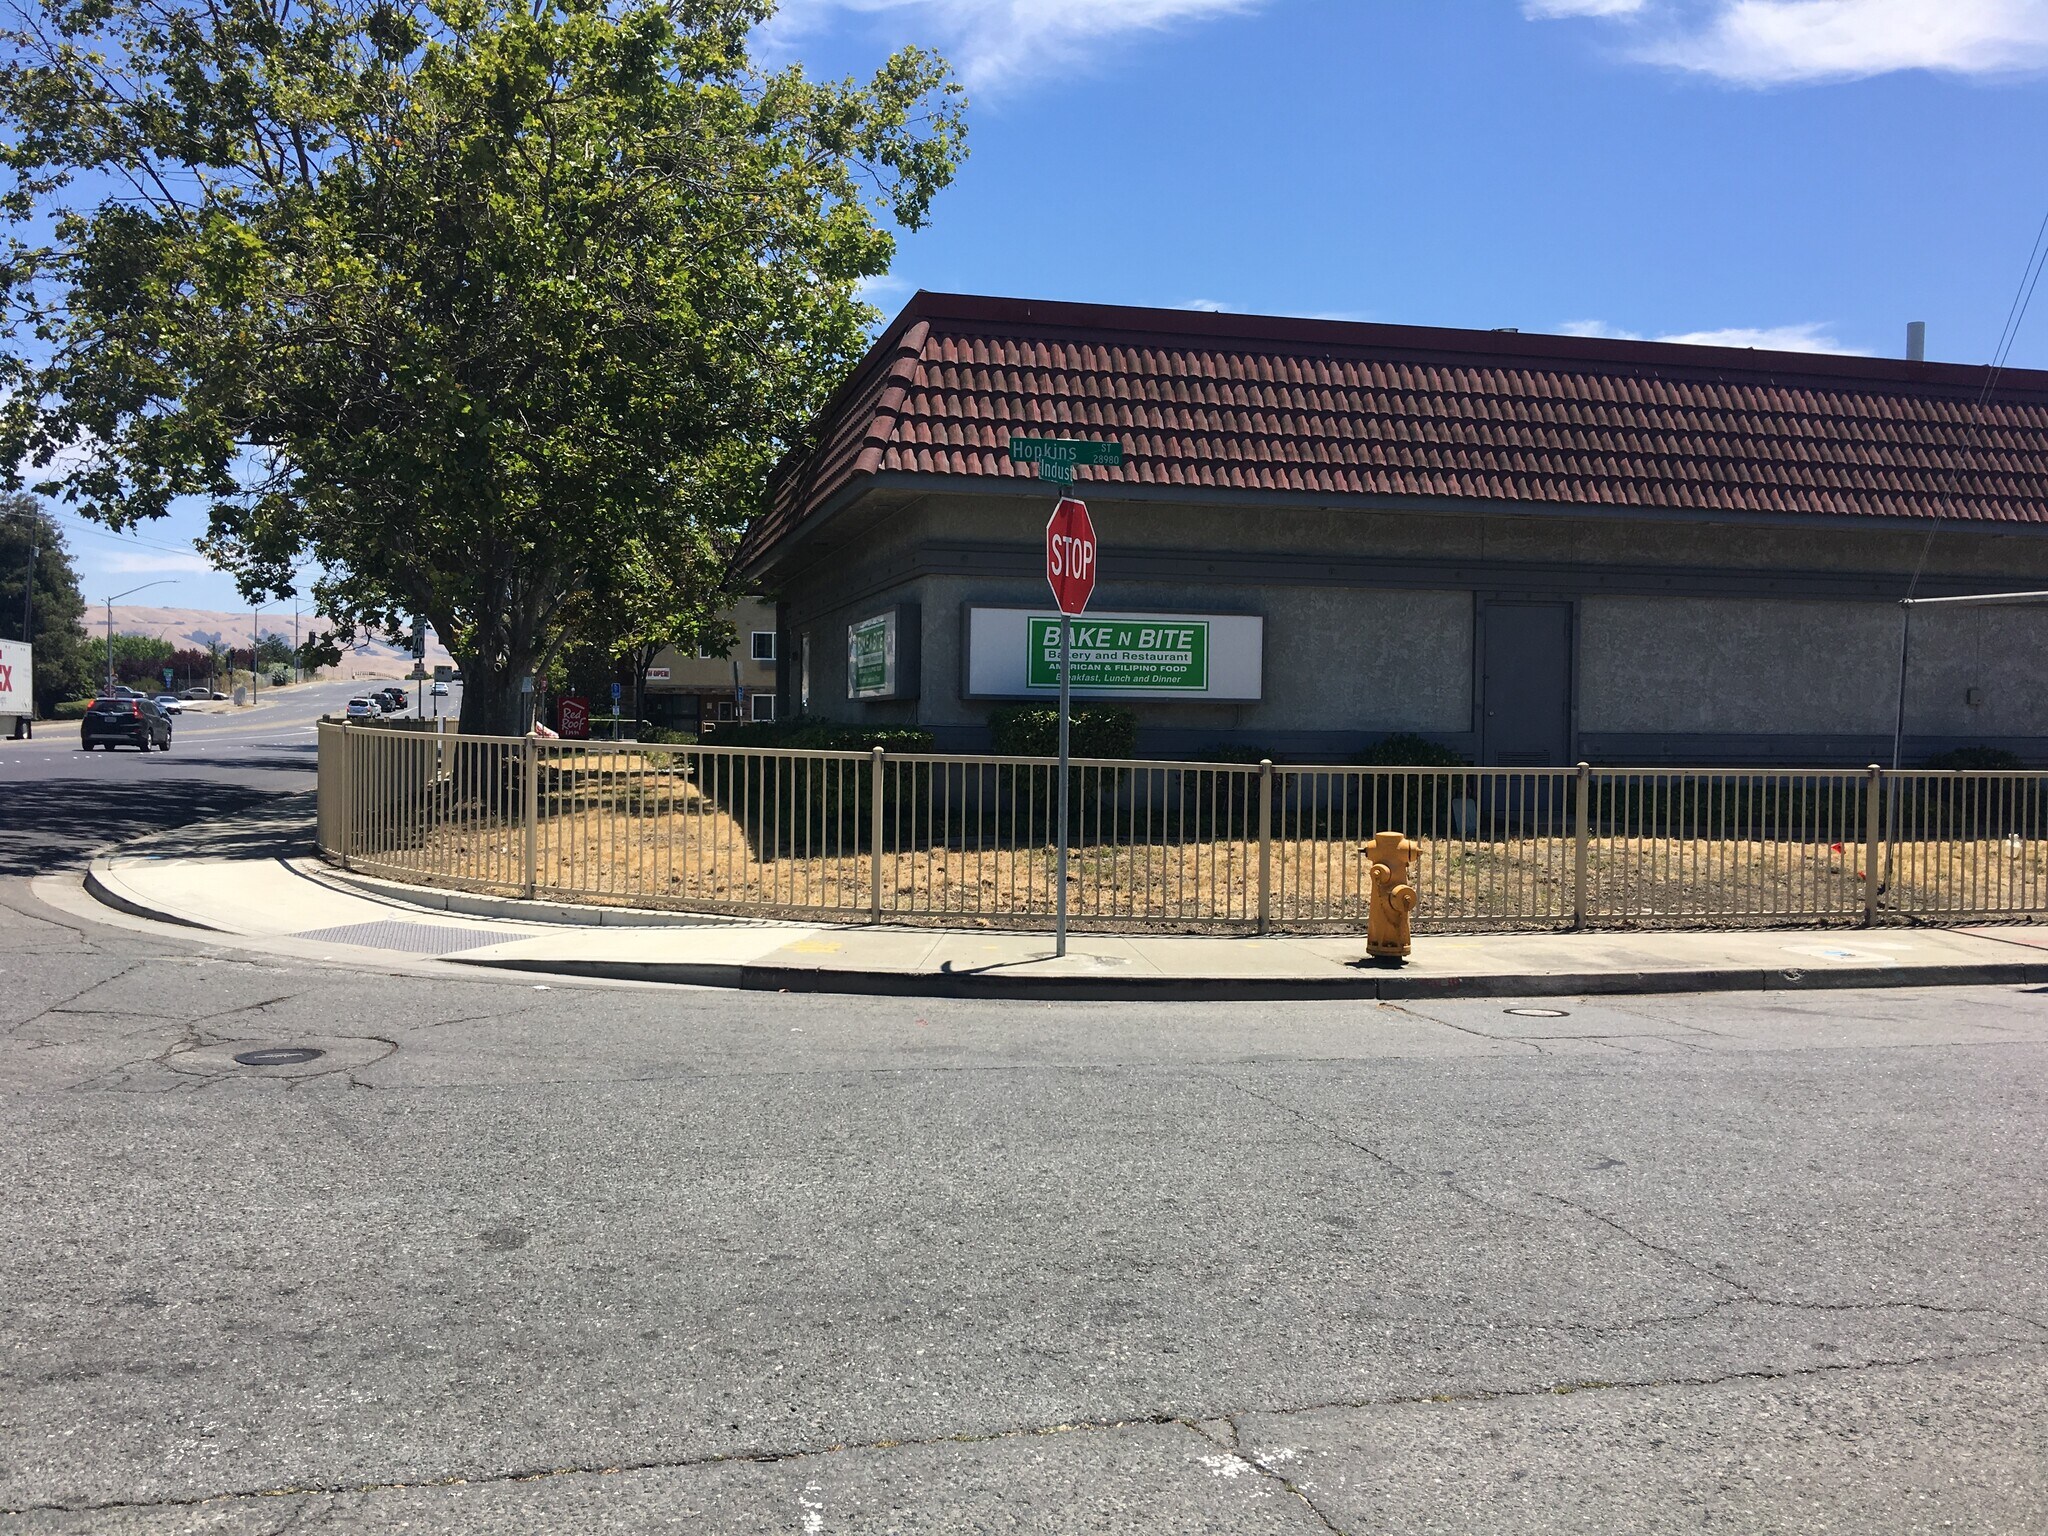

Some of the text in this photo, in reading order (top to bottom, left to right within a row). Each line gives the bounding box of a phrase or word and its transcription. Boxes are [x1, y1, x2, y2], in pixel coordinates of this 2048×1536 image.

[1013, 441, 1112, 462] Hopkins ST
[1093, 455, 1120, 465] 28980
[1051, 533, 1093, 580] STOP
[1118, 632, 1132, 646] N
[1138, 629, 1194, 649] BITE
[1048, 650, 1189, 662] Baery and Restaurant
[1115, 664, 1157, 672] FILIPINO
[1104, 674, 1131, 682] Lunch
[1133, 675, 1151, 683] and
[1152, 676, 1182, 684] Dinner
[563, 708, 581, 719] Red
[562, 718, 586, 731] Roof
